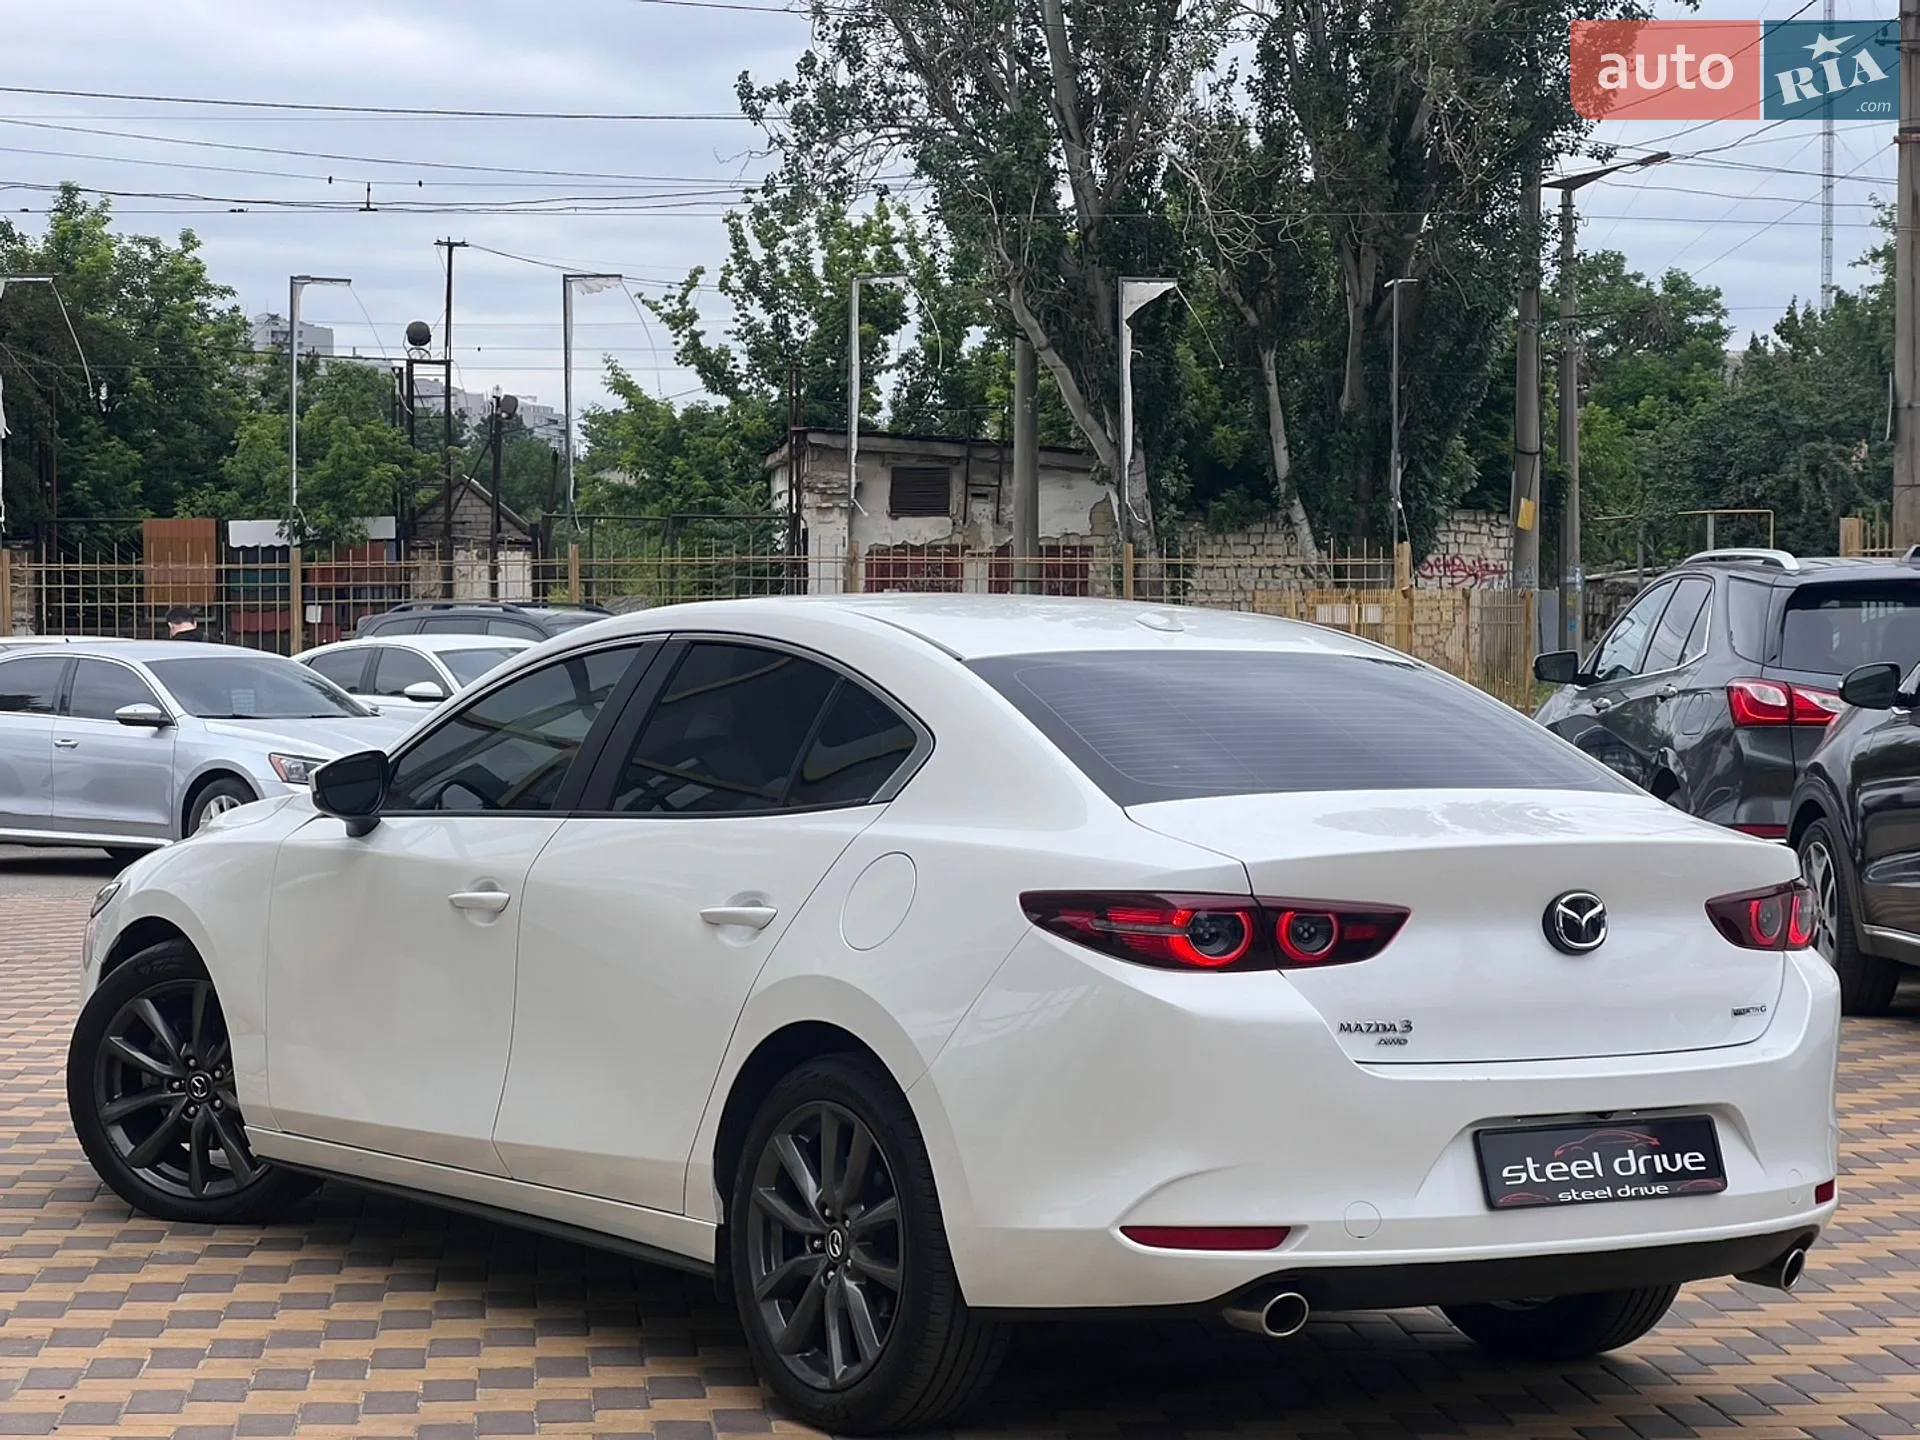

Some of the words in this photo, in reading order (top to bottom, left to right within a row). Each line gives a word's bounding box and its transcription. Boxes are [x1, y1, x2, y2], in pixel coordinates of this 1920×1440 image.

[1378, 1038, 1408, 1046] AWD
[1502, 1151, 1604, 1185] steel
[1613, 1149, 1706, 1176] drive
[1558, 1185, 1612, 1202] steel
[1617, 1183, 1669, 1198] drive
